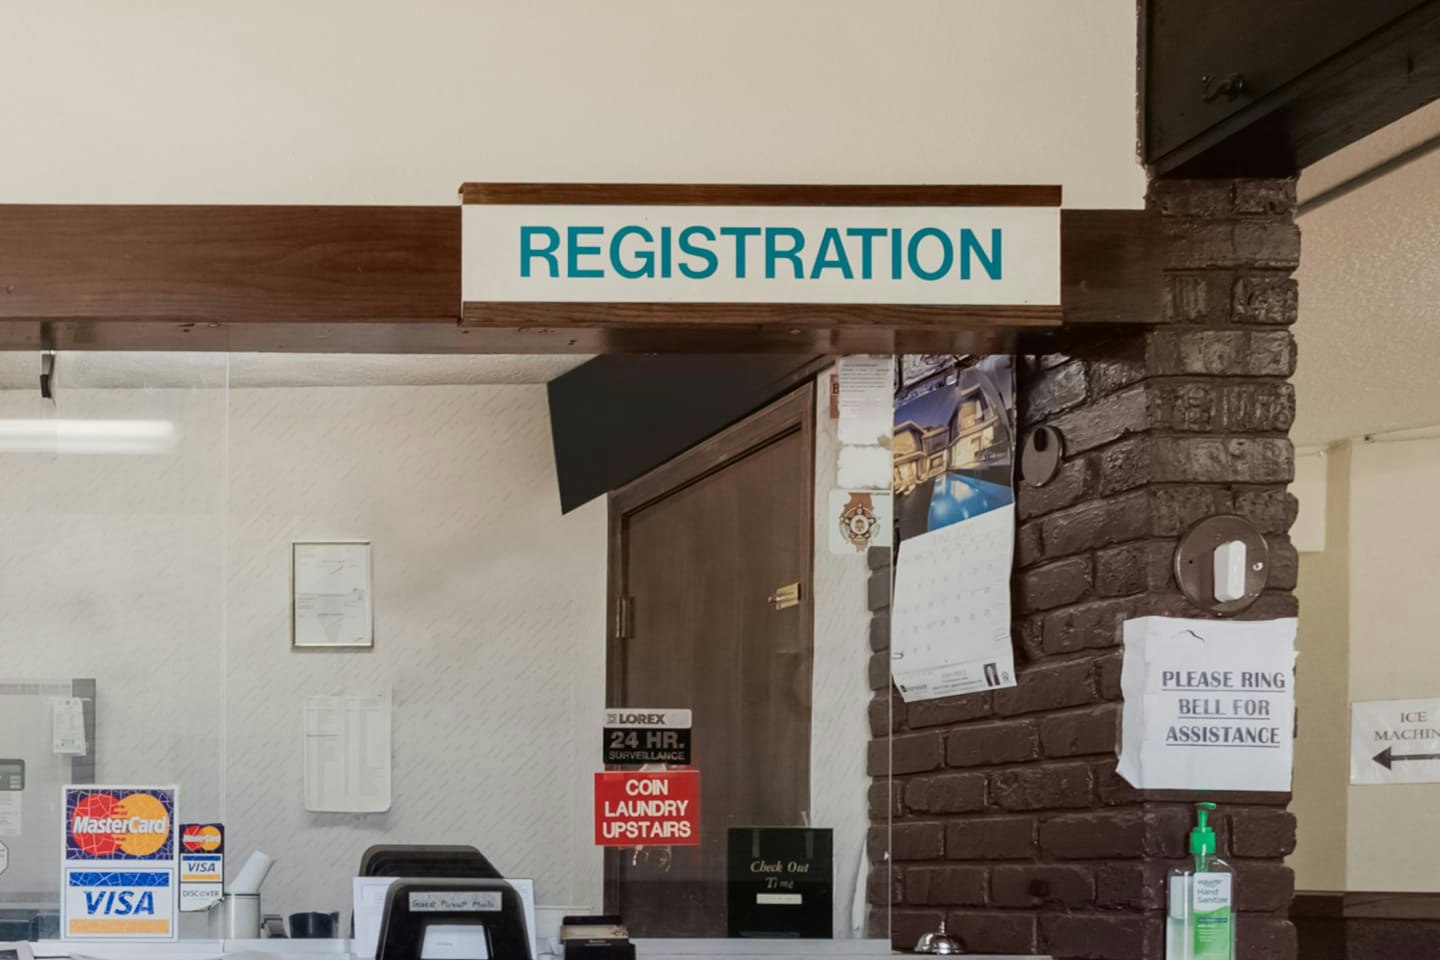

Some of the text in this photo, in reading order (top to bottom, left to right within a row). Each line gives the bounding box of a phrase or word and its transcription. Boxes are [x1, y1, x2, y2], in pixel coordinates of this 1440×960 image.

[519, 225, 1003, 281] REGISTRATION
[1162, 670, 1286, 688] PLEASE RING
[1178, 698, 1271, 716] BELL FOR
[618, 713, 666, 725] LOREX
[1400, 711, 1428, 723] ICE
[610, 731, 685, 749] 24 HR.
[1166, 725, 1281, 744] ASSISTANCE
[609, 751, 685, 760] SURVEILLANCE
[625, 779, 669, 796] COIN
[604, 800, 689, 817] LAUNDRY
[72, 816, 167, 834] MasterCard
[602, 821, 692, 838] UPSTAIRS
[187, 862, 216, 873] VISA
[750, 860, 809, 873] Check Out
[182, 889, 220, 897] DISCOVER
[84, 891, 155, 915] VISA
